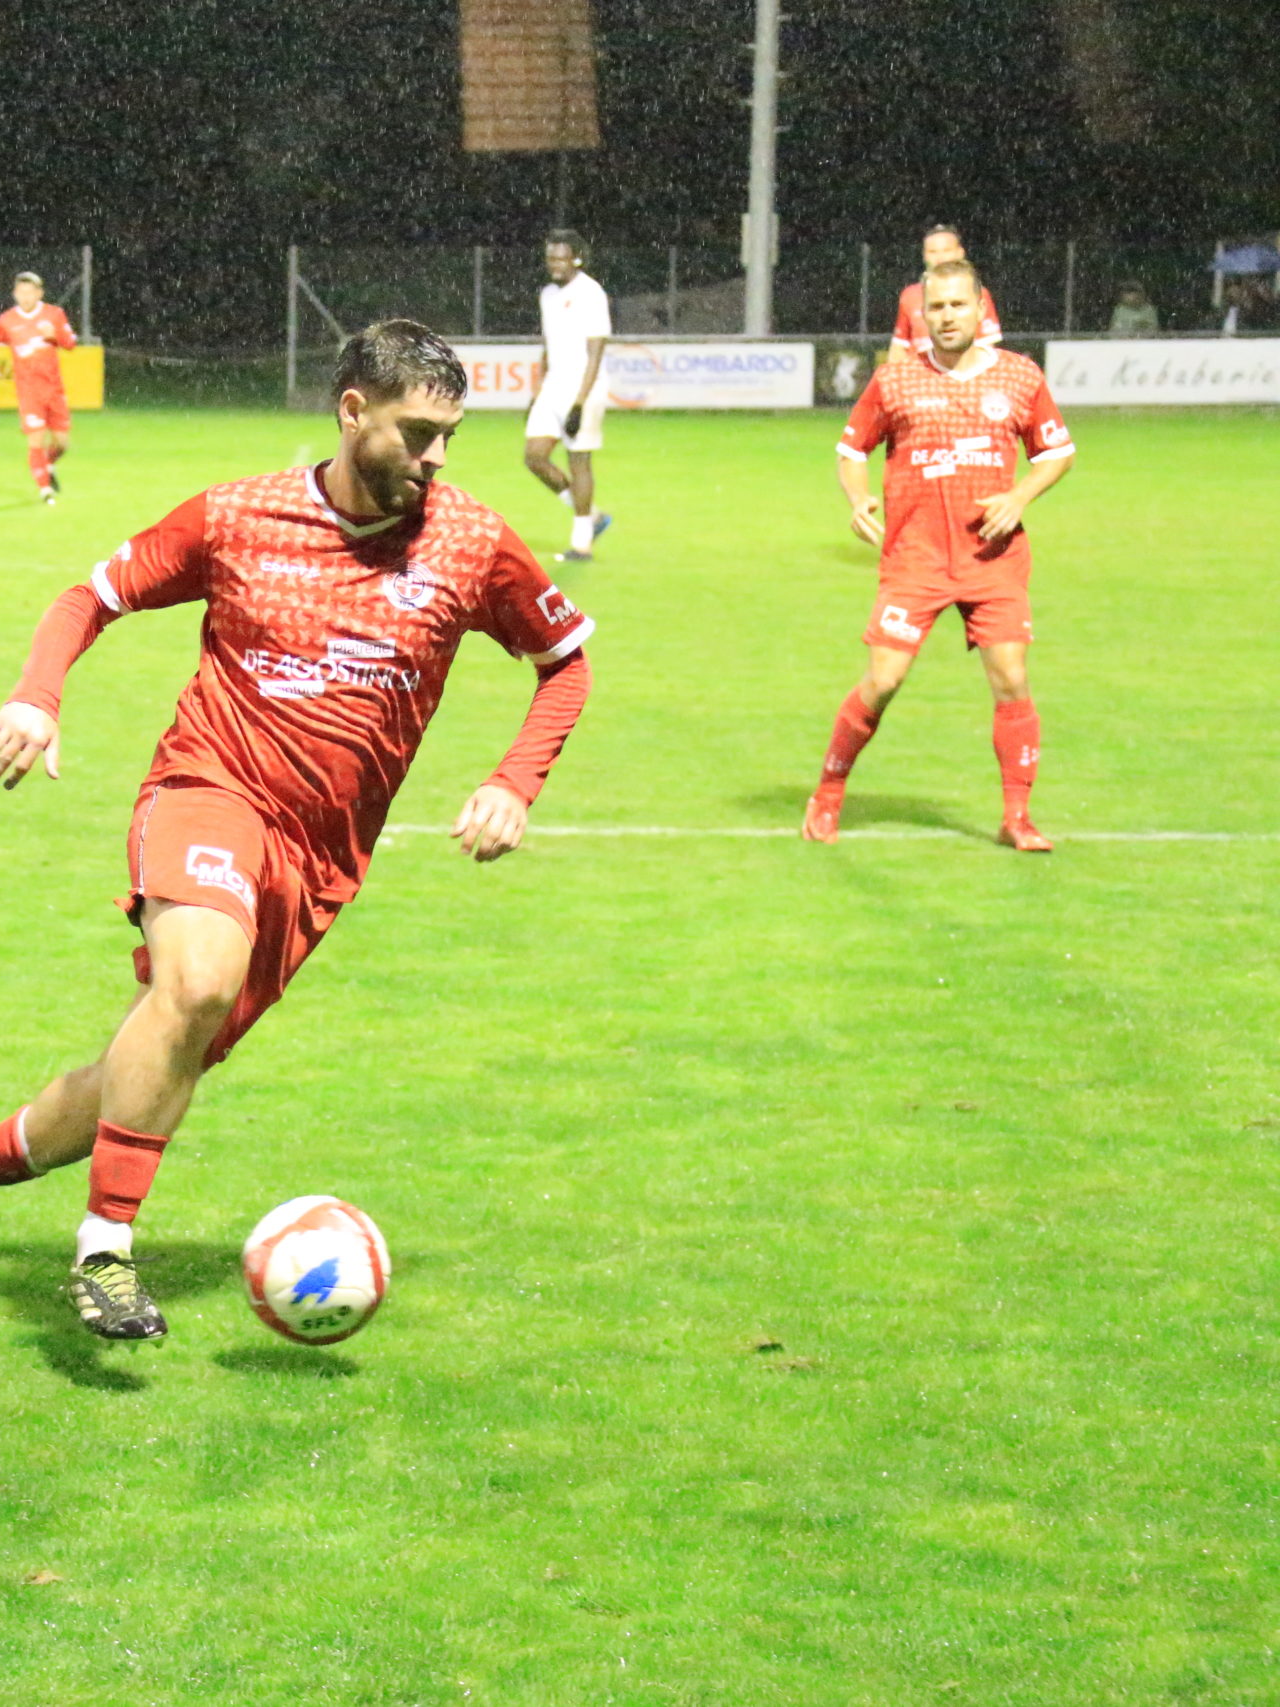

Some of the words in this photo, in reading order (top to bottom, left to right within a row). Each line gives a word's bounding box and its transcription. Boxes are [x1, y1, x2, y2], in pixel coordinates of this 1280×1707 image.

[662, 353, 798, 374] LOMBARDO
[241, 648, 270, 674] DE
[273, 654, 397, 690] AGOSTINI
